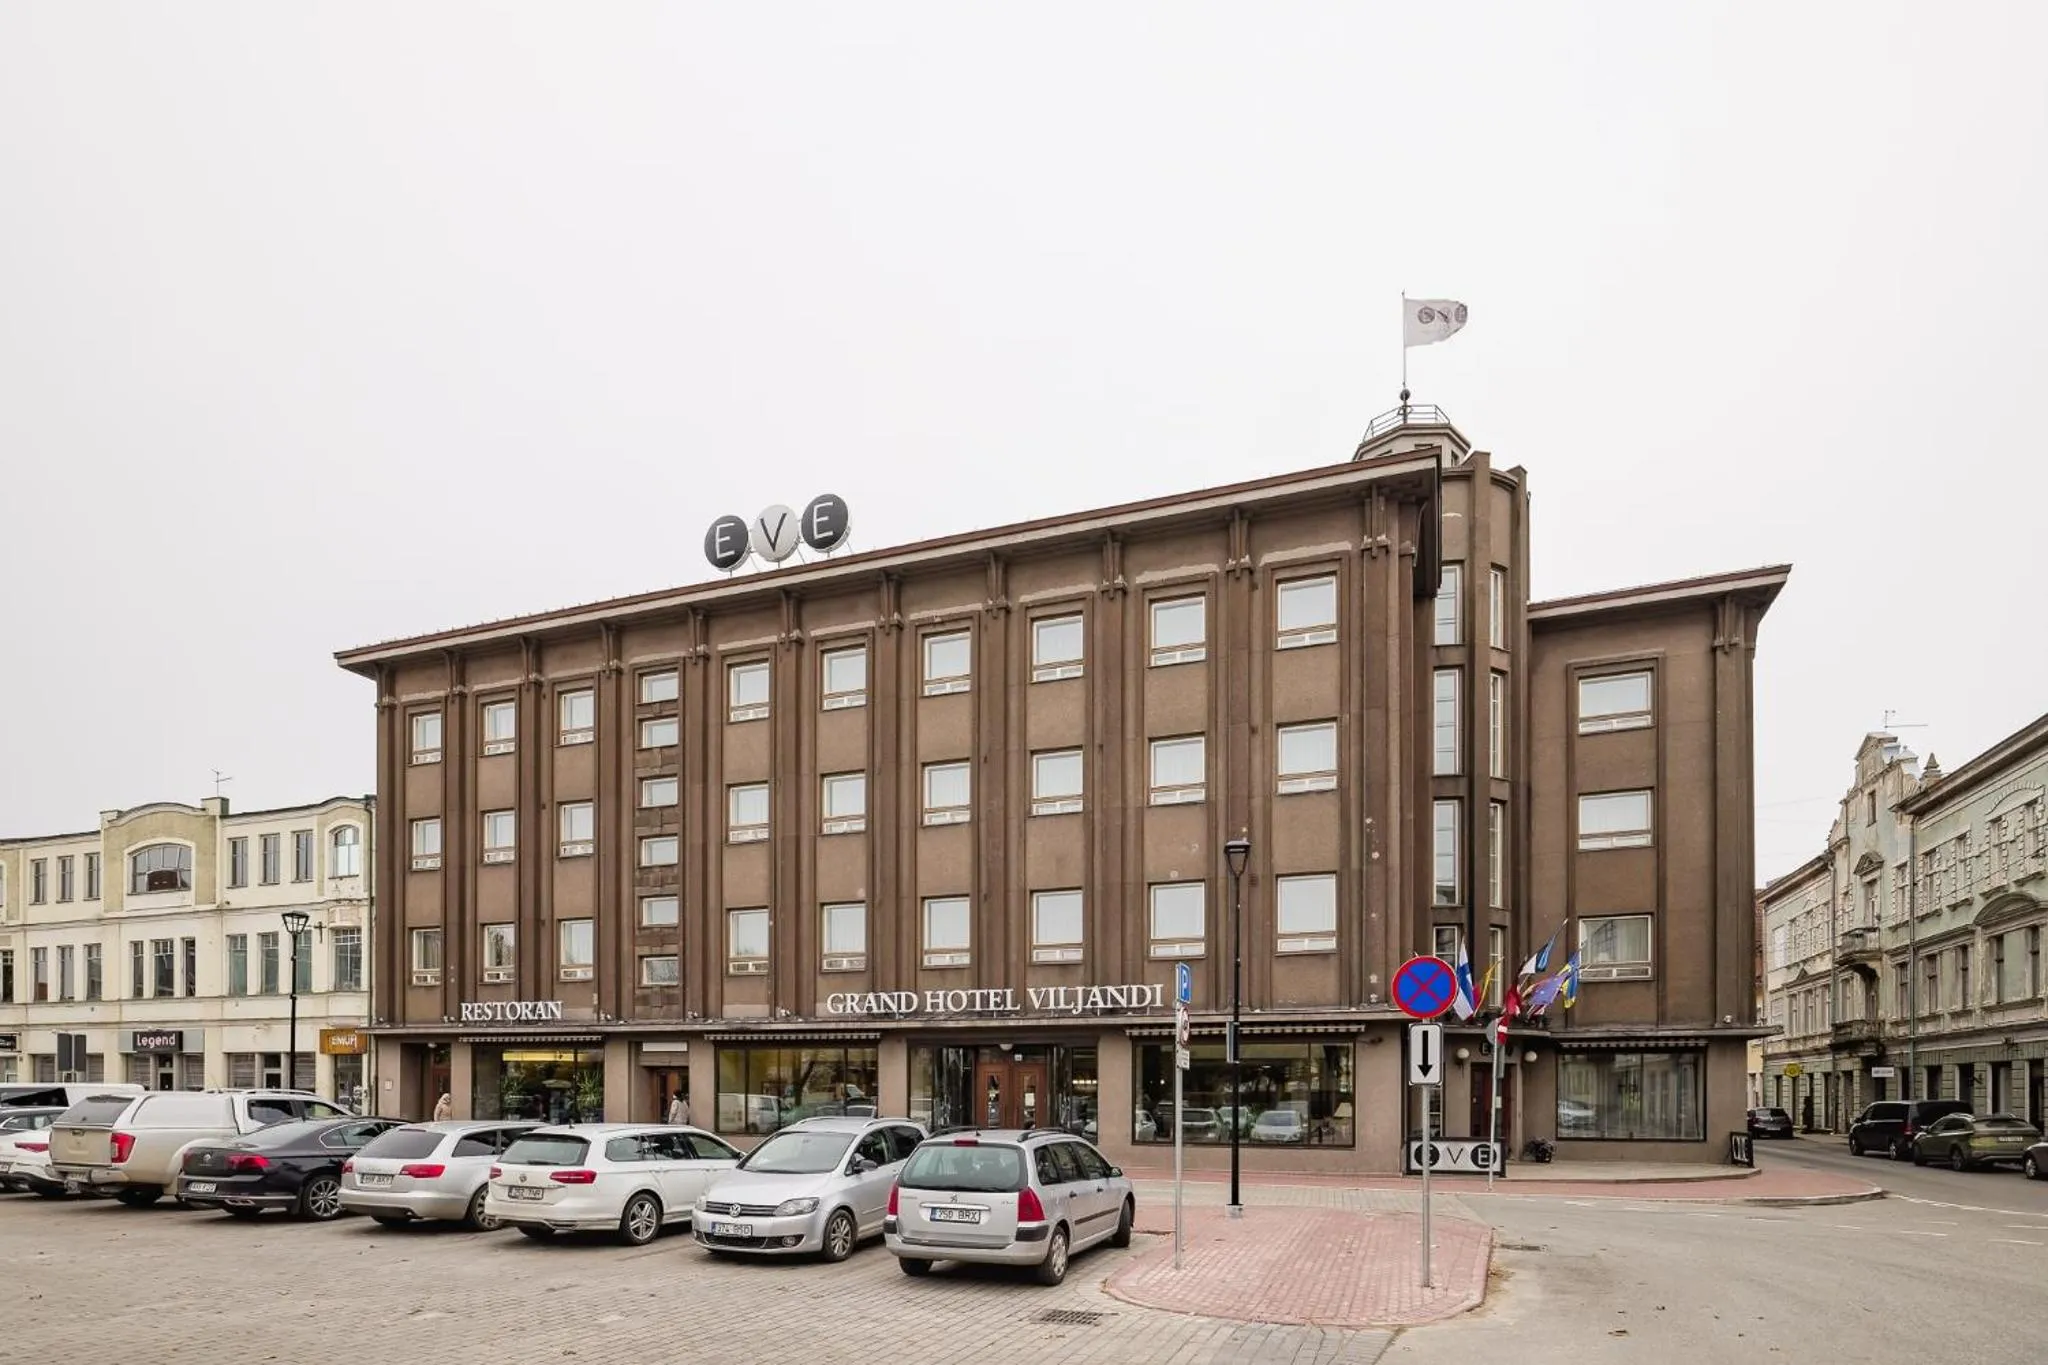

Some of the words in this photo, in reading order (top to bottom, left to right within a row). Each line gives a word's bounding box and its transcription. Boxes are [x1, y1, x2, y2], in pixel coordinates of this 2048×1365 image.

[715, 501, 834, 560] EVE
[460, 1001, 562, 1021] RESTORAN
[826, 991, 919, 1014] GRAND
[924, 988, 1021, 1012] HOTEL
[1026, 984, 1164, 1014] VILJANDI
